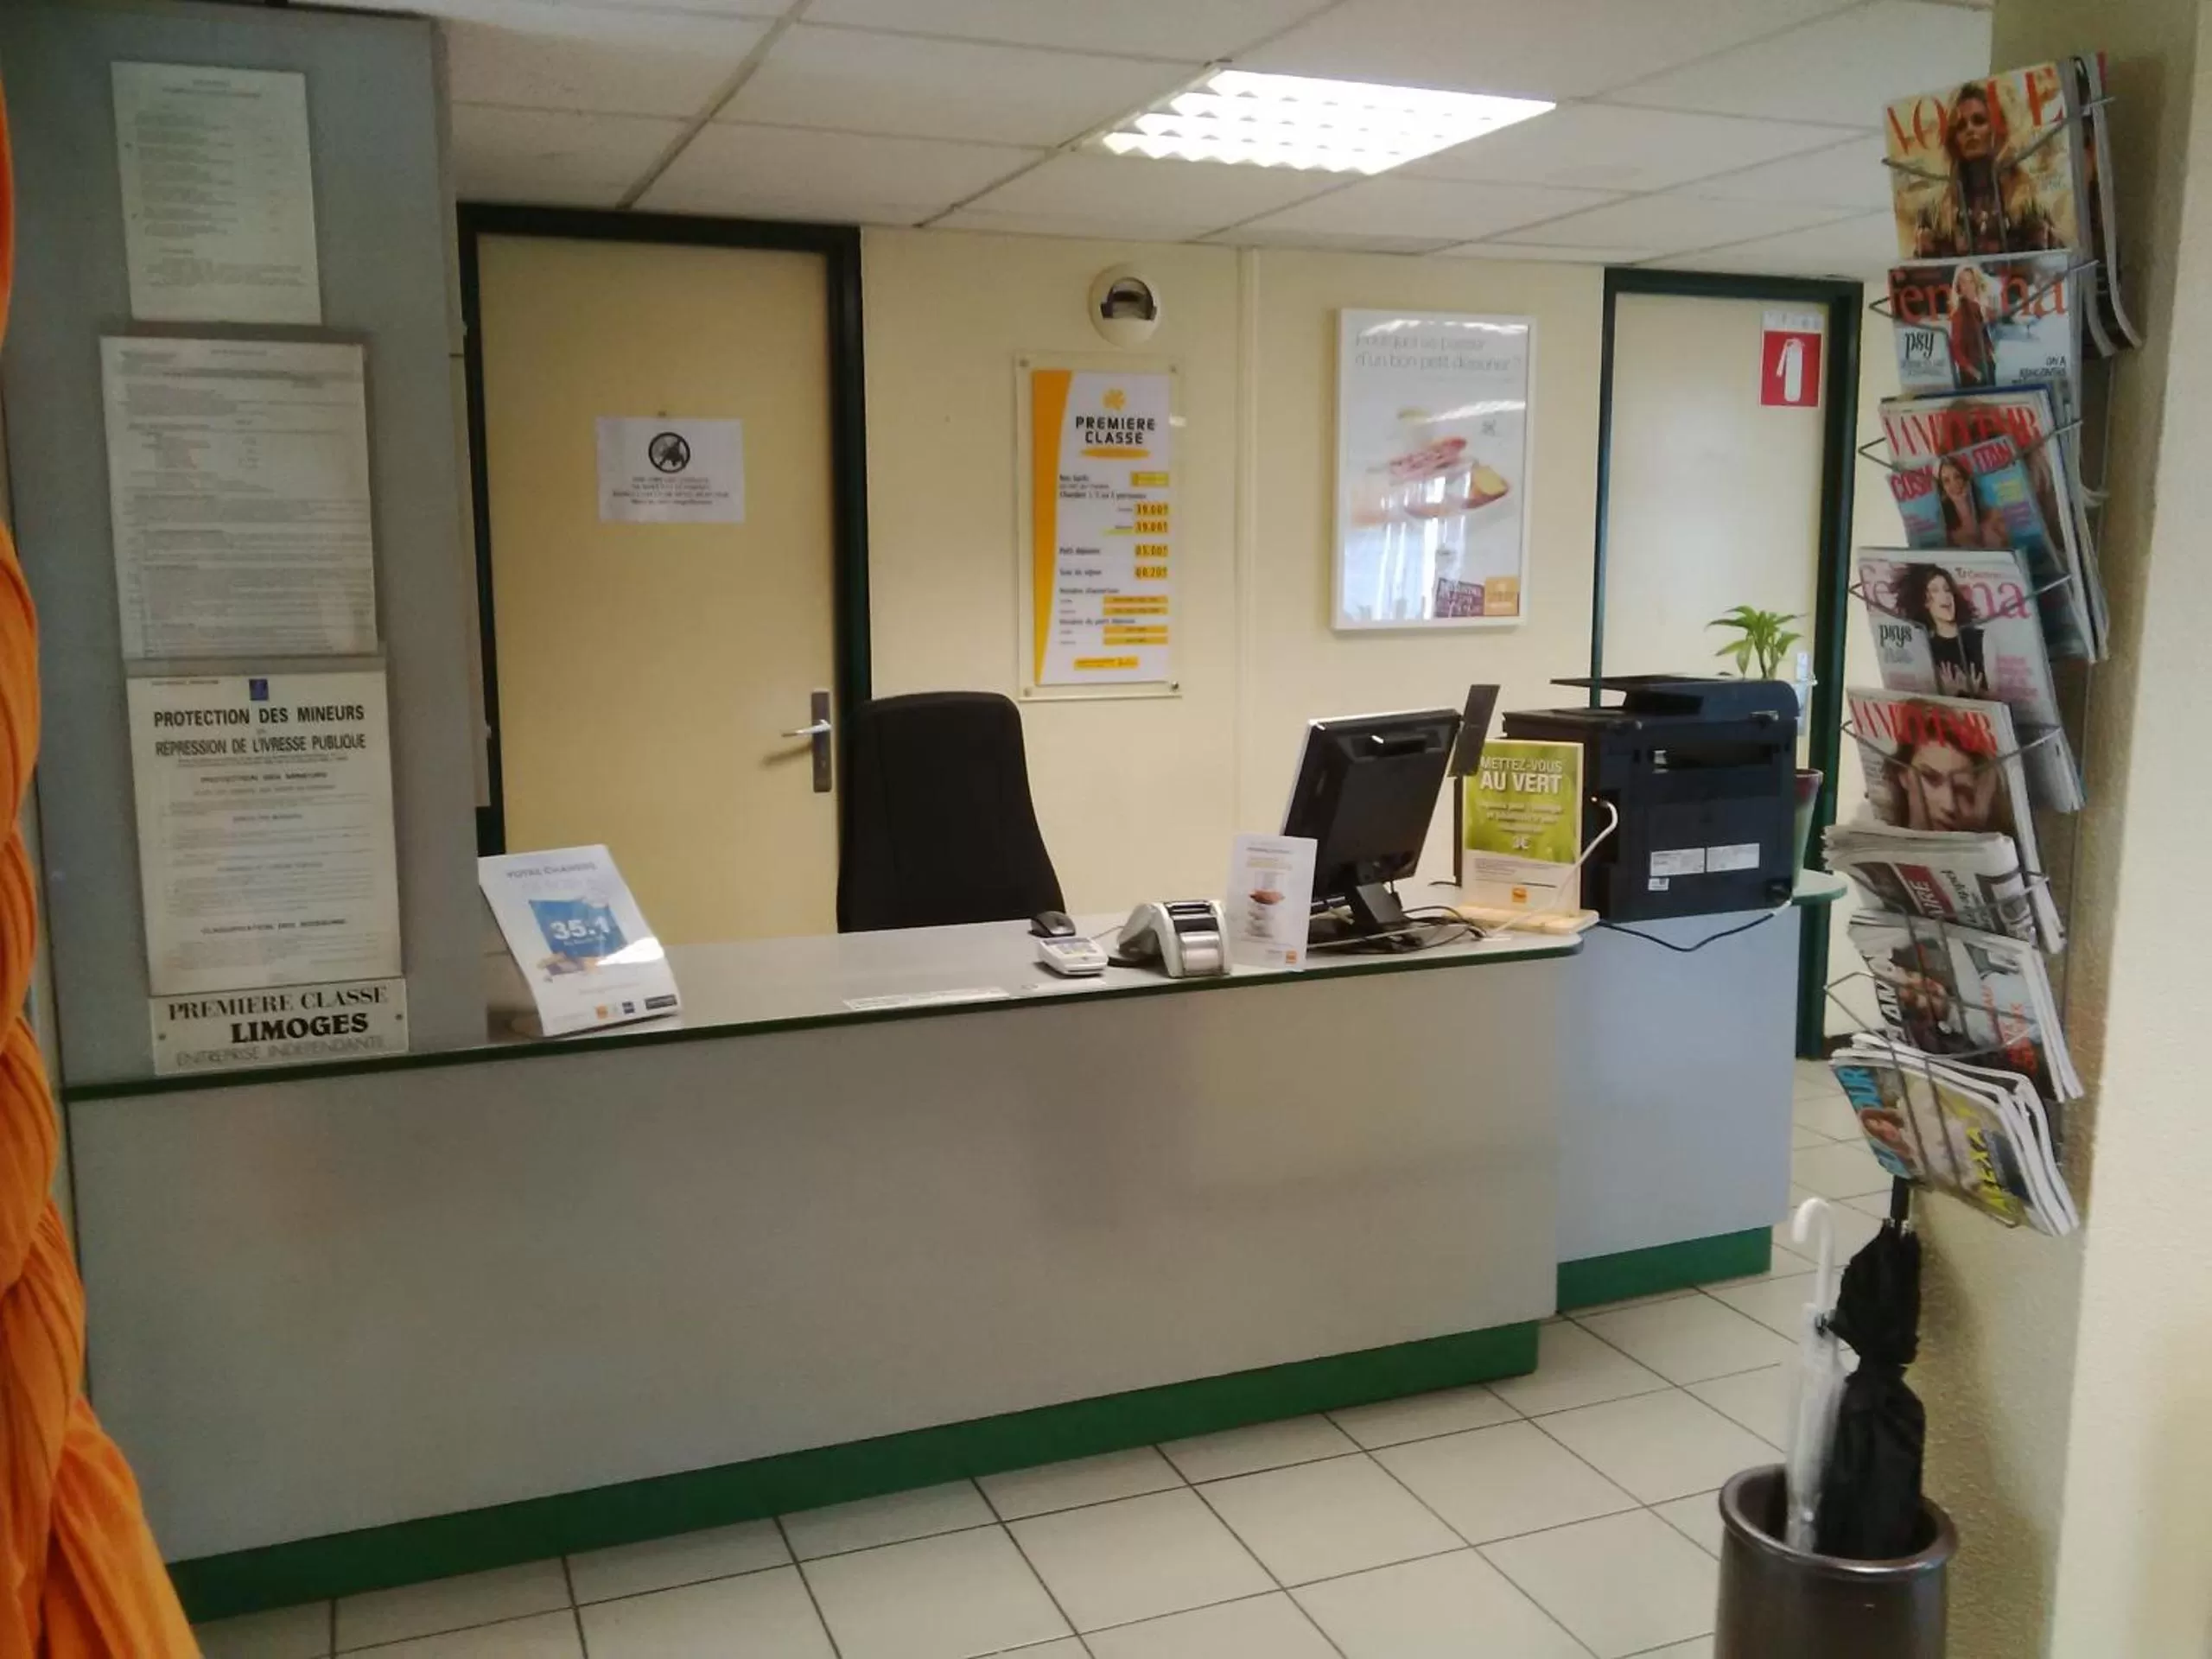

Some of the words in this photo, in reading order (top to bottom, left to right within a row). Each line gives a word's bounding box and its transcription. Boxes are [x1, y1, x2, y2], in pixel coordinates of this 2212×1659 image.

[1075, 416, 1155, 431] PREMIERE
[1084, 431, 1144, 445] CLASSE
[153, 709, 250, 727] PROTECTION
[259, 707, 288, 724] DES
[297, 704, 365, 722] MINEURS
[232, 737, 246, 753] DE
[252, 735, 306, 753] L'IVRESSE
[312, 734, 366, 751] PUBLIQUE
[1480, 756, 1563, 774] METTEZ-VOUS
[1479, 772, 1507, 792] AU
[1513, 773, 1563, 794] VERT
[168, 993, 294, 1021] PREMIERE
[301, 986, 388, 1010] CLASSE
[231, 1012, 369, 1044] LIMOGES
